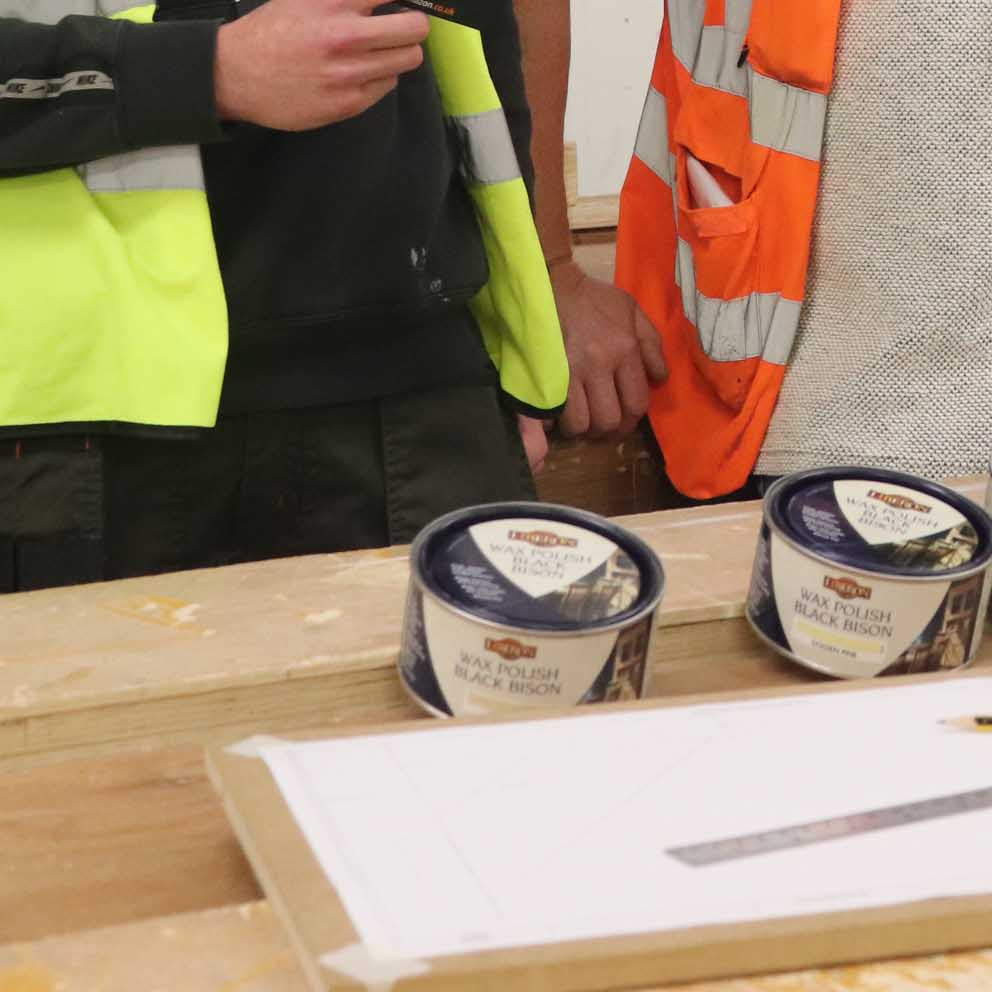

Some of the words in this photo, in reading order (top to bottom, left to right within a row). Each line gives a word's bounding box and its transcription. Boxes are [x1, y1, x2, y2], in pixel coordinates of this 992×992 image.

[794, 599, 839, 628] BLACK
[843, 618, 893, 638] BISON
[800, 586, 831, 609] WAX
[834, 601, 892, 624] POLISH
